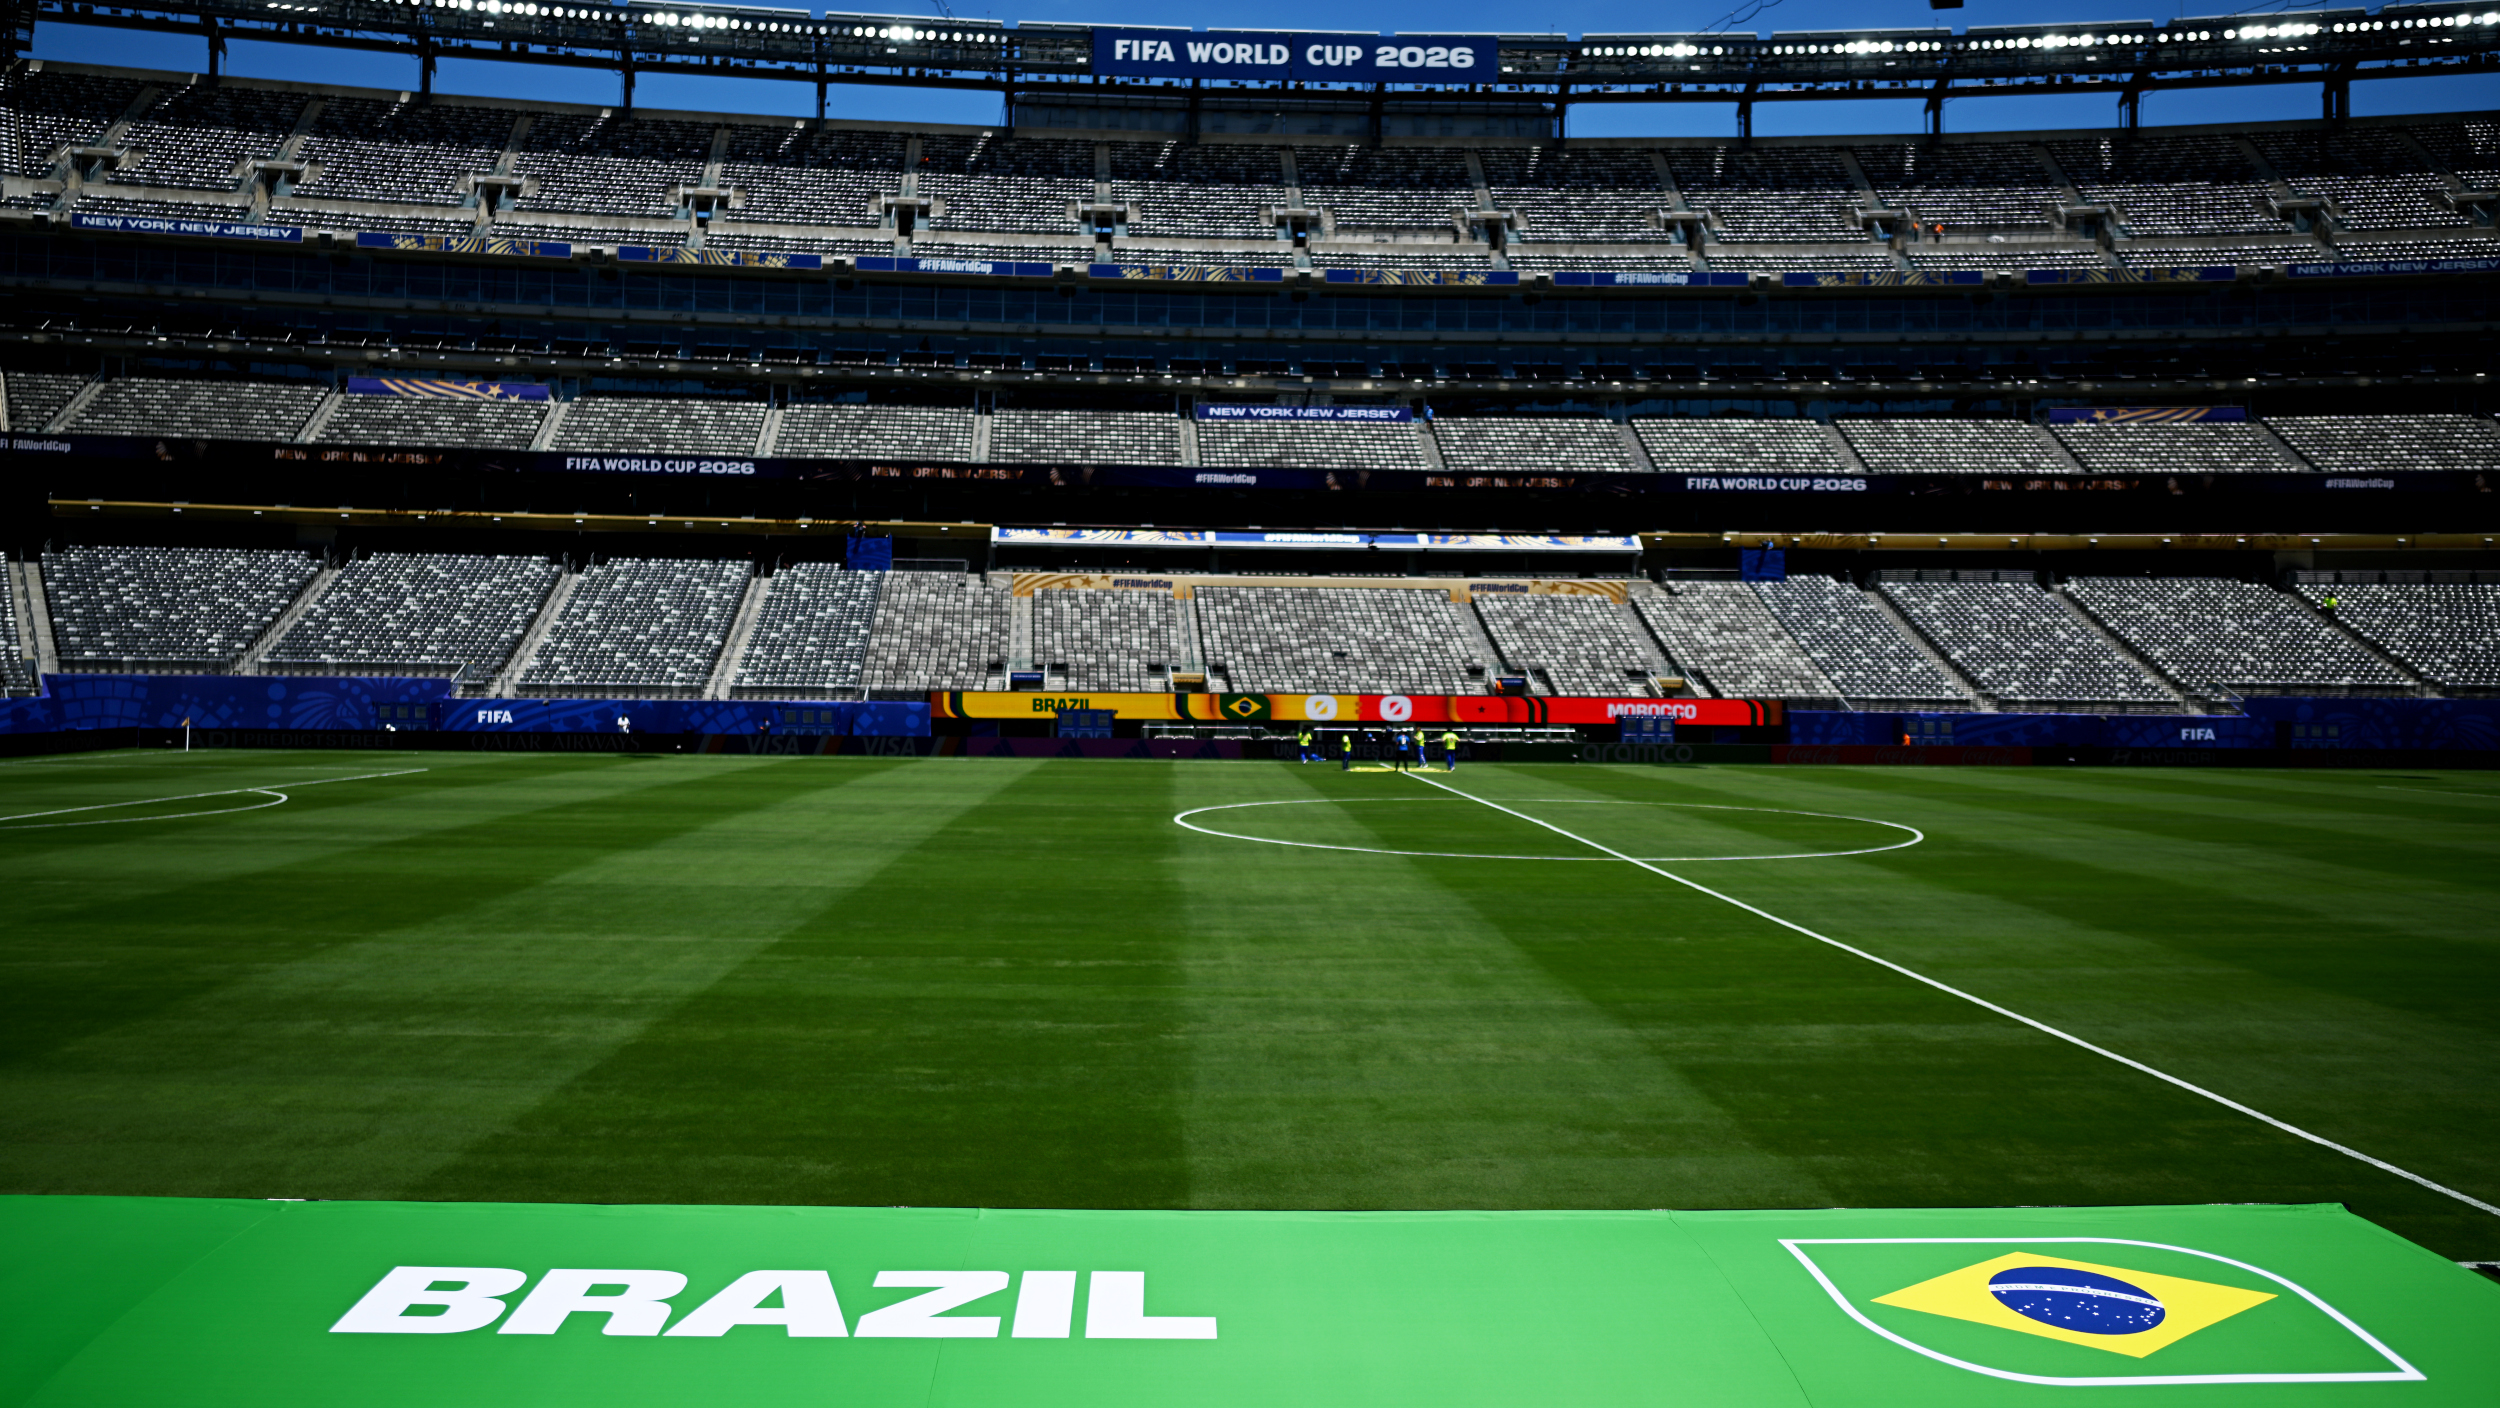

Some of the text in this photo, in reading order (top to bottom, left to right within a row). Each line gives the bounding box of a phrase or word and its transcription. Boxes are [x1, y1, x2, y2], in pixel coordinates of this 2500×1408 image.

[1115, 39, 1475, 69] FIFA WORLD CUP 2026
[82, 216, 292, 239] NEW YORK NEW JERSEY
[918, 259, 993, 275] #FIFAWorldCup
[2297, 259, 2500, 275] NEW YORK NEW JERSEY
[1615, 272, 1689, 285] #FIFAWorldCup
[1209, 407, 1401, 419] NEW YORK NEW JERSEY
[274, 448, 307, 461] NEW
[352, 451, 386, 463] NEW
[388, 452, 443, 465] JERSEY
[566, 456, 756, 475] FIFA WORLD CUP 2026
[871, 465, 901, 477] NEW
[941, 467, 972, 479] NEW
[973, 468, 1024, 480] JERSEY
[1195, 473, 1257, 486] #FIFAWorldCup
[1425, 476, 1455, 487] NEW
[1494, 477, 1524, 488] NEW
[1525, 477, 1576, 489] JERSEY
[1686, 477, 1867, 492] FIFA WORLD CUP 2026
[1982, 479, 2013, 491] NEW
[2053, 479, 2085, 491] NEW
[2086, 479, 2140, 491] JERSEY
[2325, 478, 2395, 491] #FIFAWorldCup
[1113, 578, 1173, 590] #FIFAWorldCup
[1469, 583, 1529, 594] #FIFAWorldCup
[478, 710, 513, 723] FIFA
[1606, 703, 1697, 720] MOROCCO
[184, 731, 398, 748] ADI PREDICTSTREET
[2181, 728, 2216, 741] FIFA
[45, 733, 102, 753] Lenovo
[471, 734, 641, 752] QATAR AIRWAYS
[746, 735, 801, 755] VISA
[860, 736, 917, 756] VISA
[1581, 743, 1694, 763] aramco
[2141, 751, 2216, 764] HYUNDAI
[2325, 750, 2396, 767] Lenovo
[2434, 751, 2500, 767] Lenov
[329, 1265, 1218, 1339] BRAZIL
